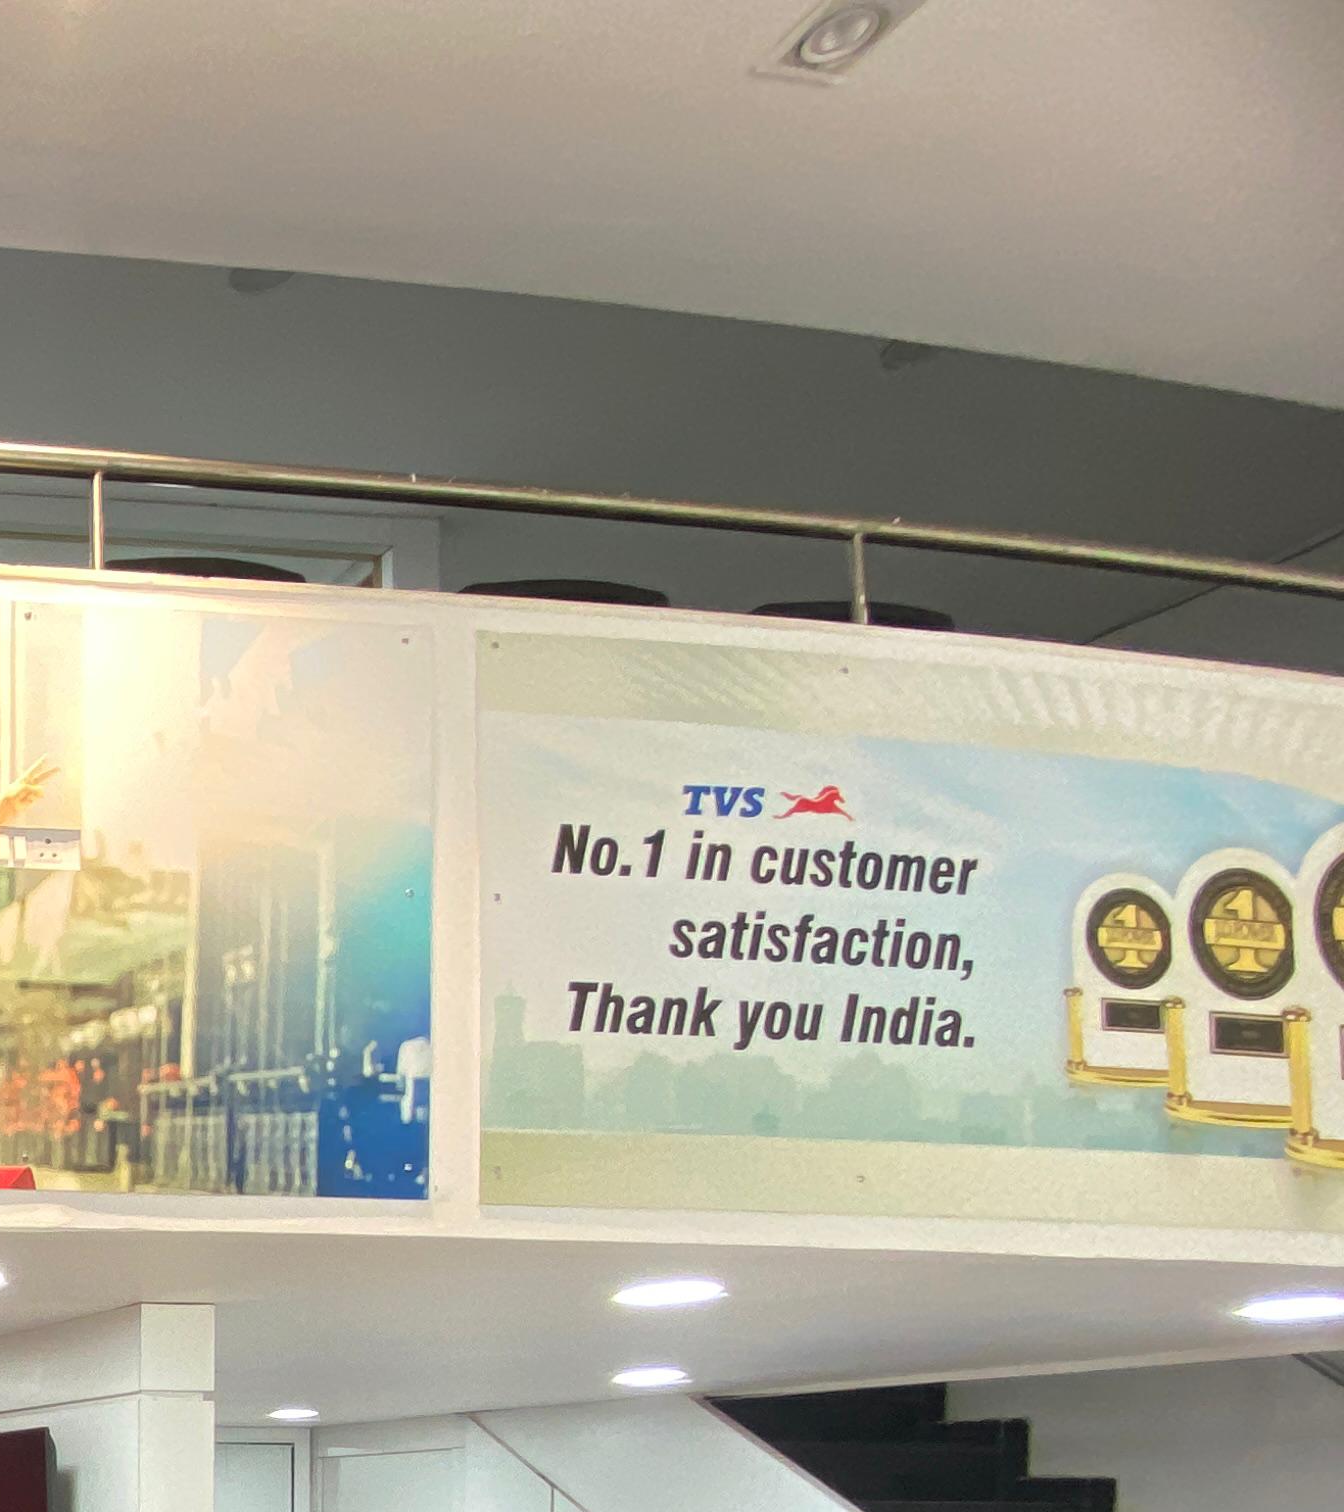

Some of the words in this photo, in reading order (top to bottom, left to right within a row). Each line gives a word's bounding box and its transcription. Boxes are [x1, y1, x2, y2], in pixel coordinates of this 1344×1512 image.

[682, 785, 765, 819] TVS
[552, 824, 665, 878] No.1
[685, 830, 732, 881] in
[750, 841, 978, 895] customer
[669, 911, 973, 980] satisfaction,
[568, 982, 722, 1037] Thank
[734, 1001, 823, 1050] you
[840, 994, 975, 1048] India.
